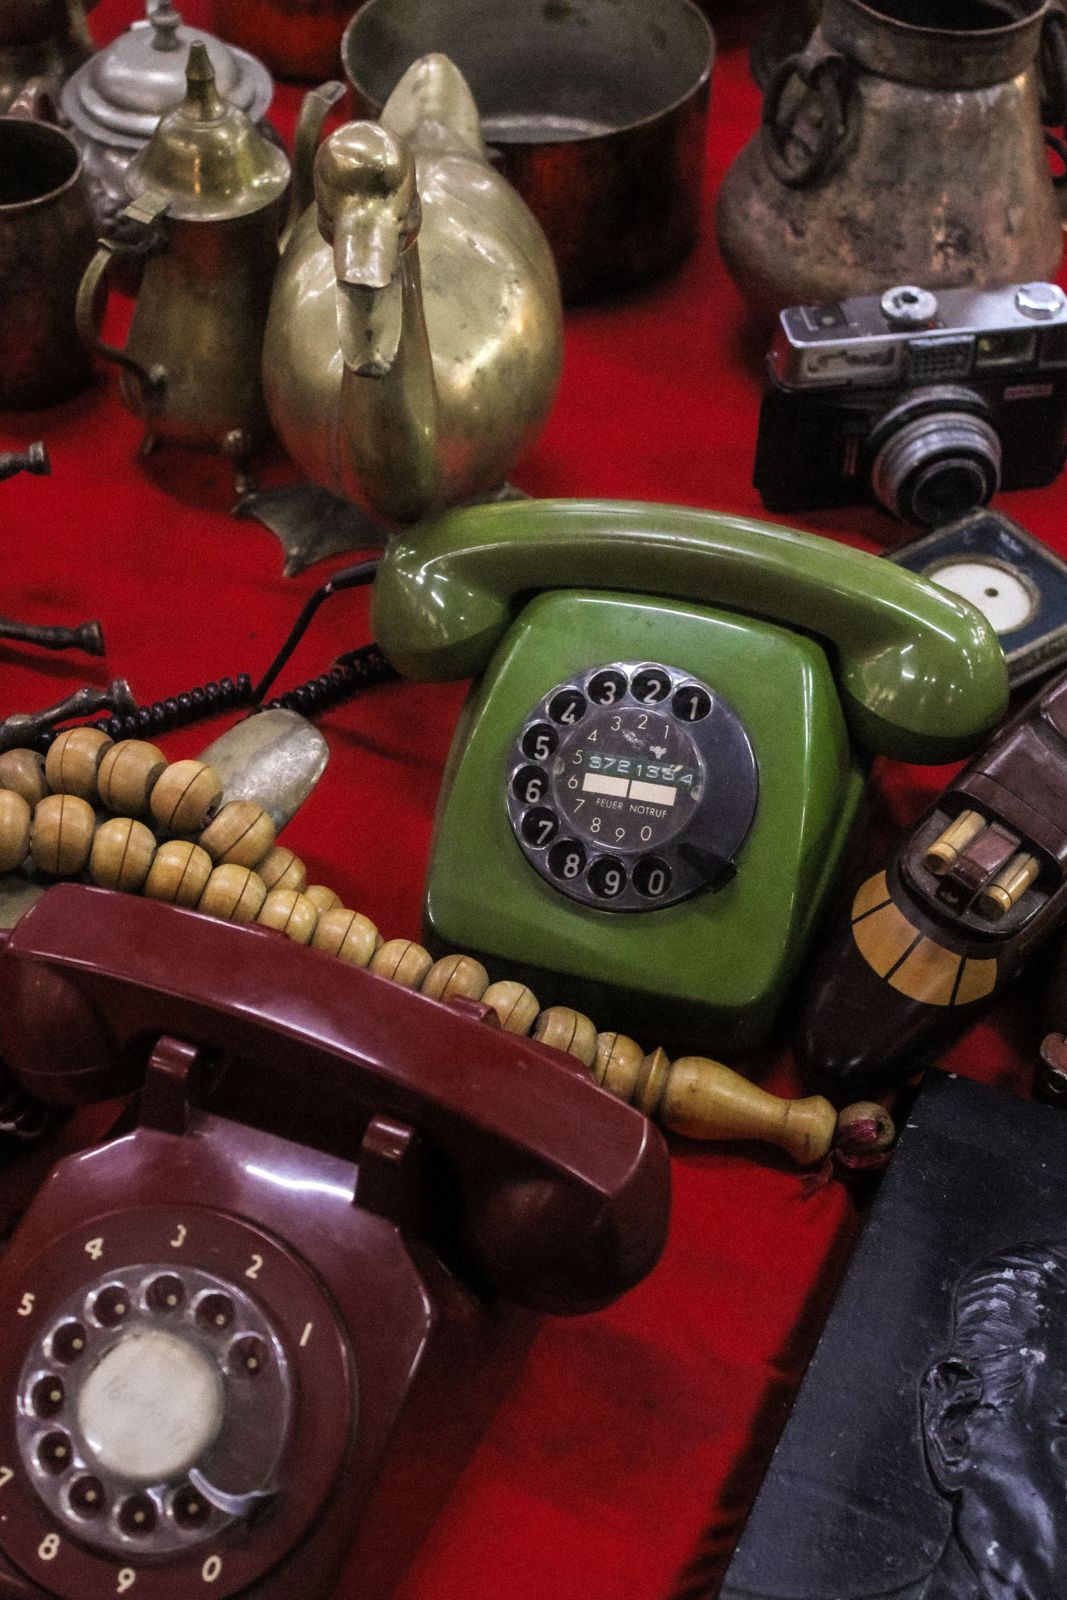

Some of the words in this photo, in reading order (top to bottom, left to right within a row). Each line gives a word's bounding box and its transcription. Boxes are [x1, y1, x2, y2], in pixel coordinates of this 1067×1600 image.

[600, 681, 616, 705] 3
[644, 680, 660, 704] 2
[561, 703, 575, 723] 4
[689, 696, 699, 719] 1
[611, 716, 621, 731] 3
[638, 714, 648, 729] 2
[664, 725, 669, 739] 1
[588, 730, 597, 742] 4
[534, 736, 549, 760] 5
[572, 750, 583, 764] 5
[526, 779, 543, 802] 6
[568, 776, 578, 789] 6
[573, 799, 585, 813] 7
[596, 798, 623, 809] FEUER
[630, 804, 667, 818] NOTRUF
[536, 820, 552, 844] 7
[591, 818, 601, 833] 8
[616, 828, 625, 841] 9
[641, 826, 652, 841] 0
[563, 854, 579, 878] 8
[605, 871, 620, 895] 9
[648, 870, 665, 895] 0
[170, 1225, 187, 1248] 3
[84, 1238, 104, 1260] 4
[245, 1255, 263, 1279] 2
[17, 1293, 36, 1316] 5
[299, 1322, 313, 1346] 1
[38, 1533, 60, 1561] 8
[201, 1556, 222, 1582] 0
[116, 1568, 136, 1594] 9
